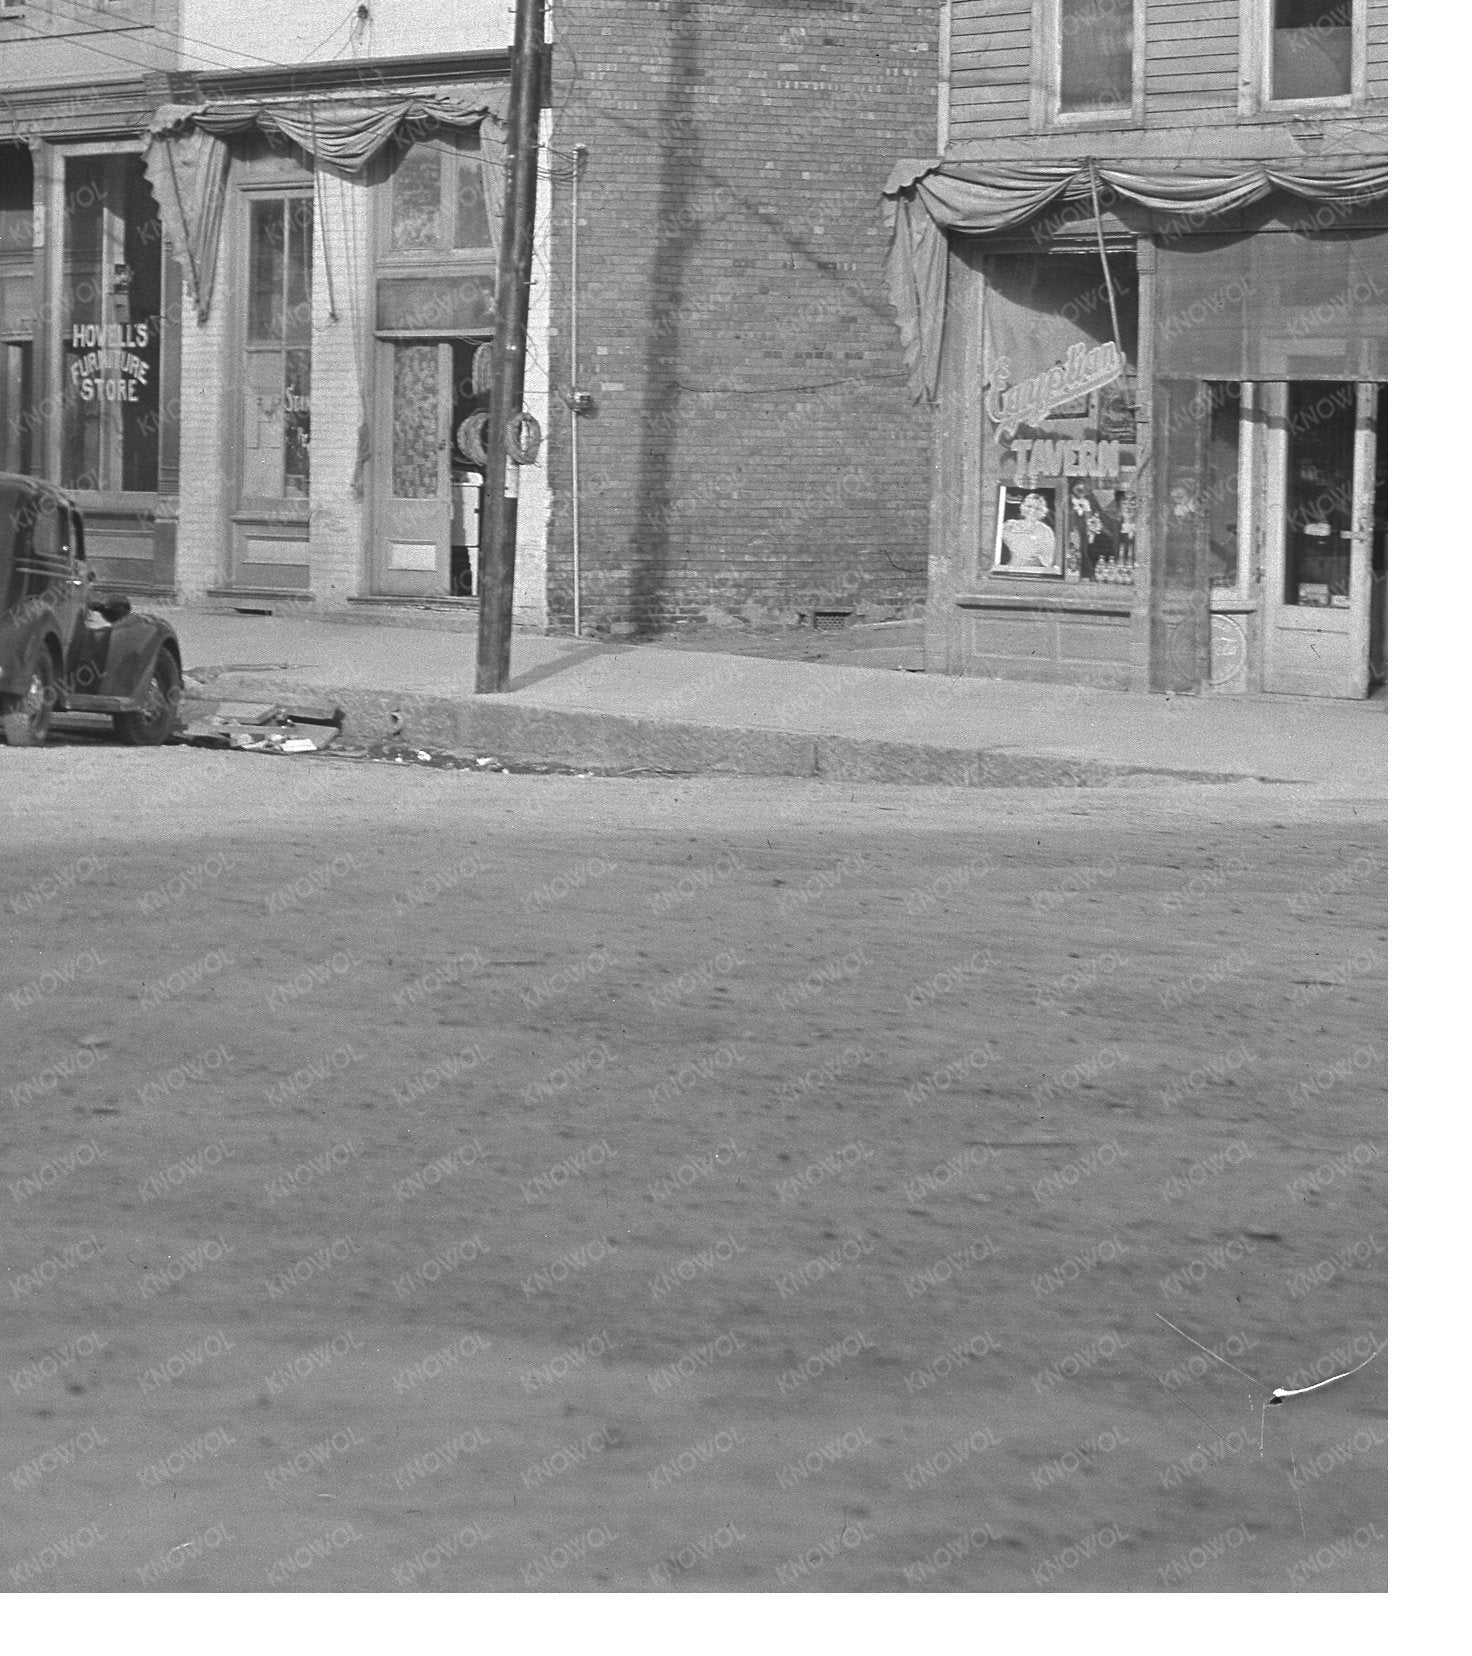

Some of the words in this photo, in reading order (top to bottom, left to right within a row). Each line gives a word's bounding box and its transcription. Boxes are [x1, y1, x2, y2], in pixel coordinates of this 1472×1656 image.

[72, 323, 148, 348] HOWELL'S
[71, 350, 150, 385] FURNITURE
[80, 378, 139, 401] STORE
[1012, 440, 1119, 476] TAVERN
